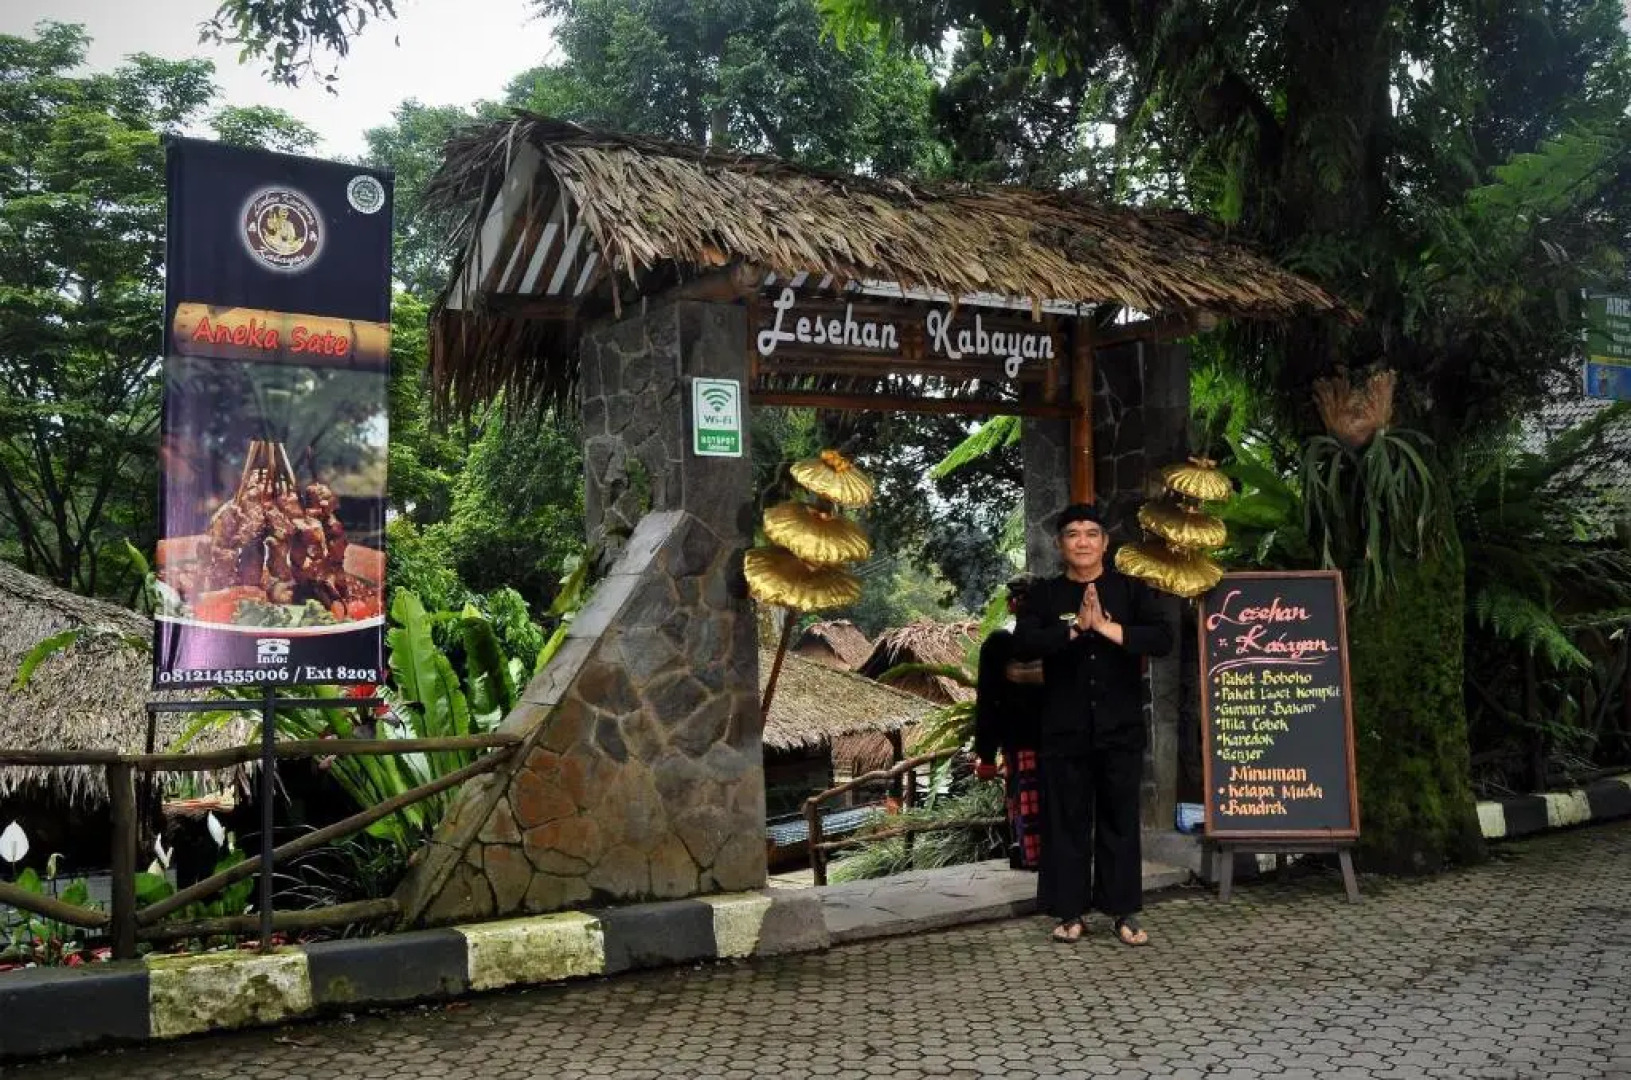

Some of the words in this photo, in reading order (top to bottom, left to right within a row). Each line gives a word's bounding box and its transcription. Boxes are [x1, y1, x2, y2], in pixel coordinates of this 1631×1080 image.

[192, 315, 280, 351] Aneka
[290, 323, 350, 358] Sate
[757, 287, 899, 356] Lesehan
[926, 309, 1055, 378] Kabayan
[1206, 590, 1311, 631] Lesehan
[256, 653, 288, 664] Info:
[160, 668, 289, 683] 081214555006
[306, 666, 333, 680] Ext
[337, 666, 377, 682] 8203
[1221, 671, 1256, 685] Paket
[1221, 687, 1256, 701] Paket
[1229, 765, 1308, 782] Minuman
